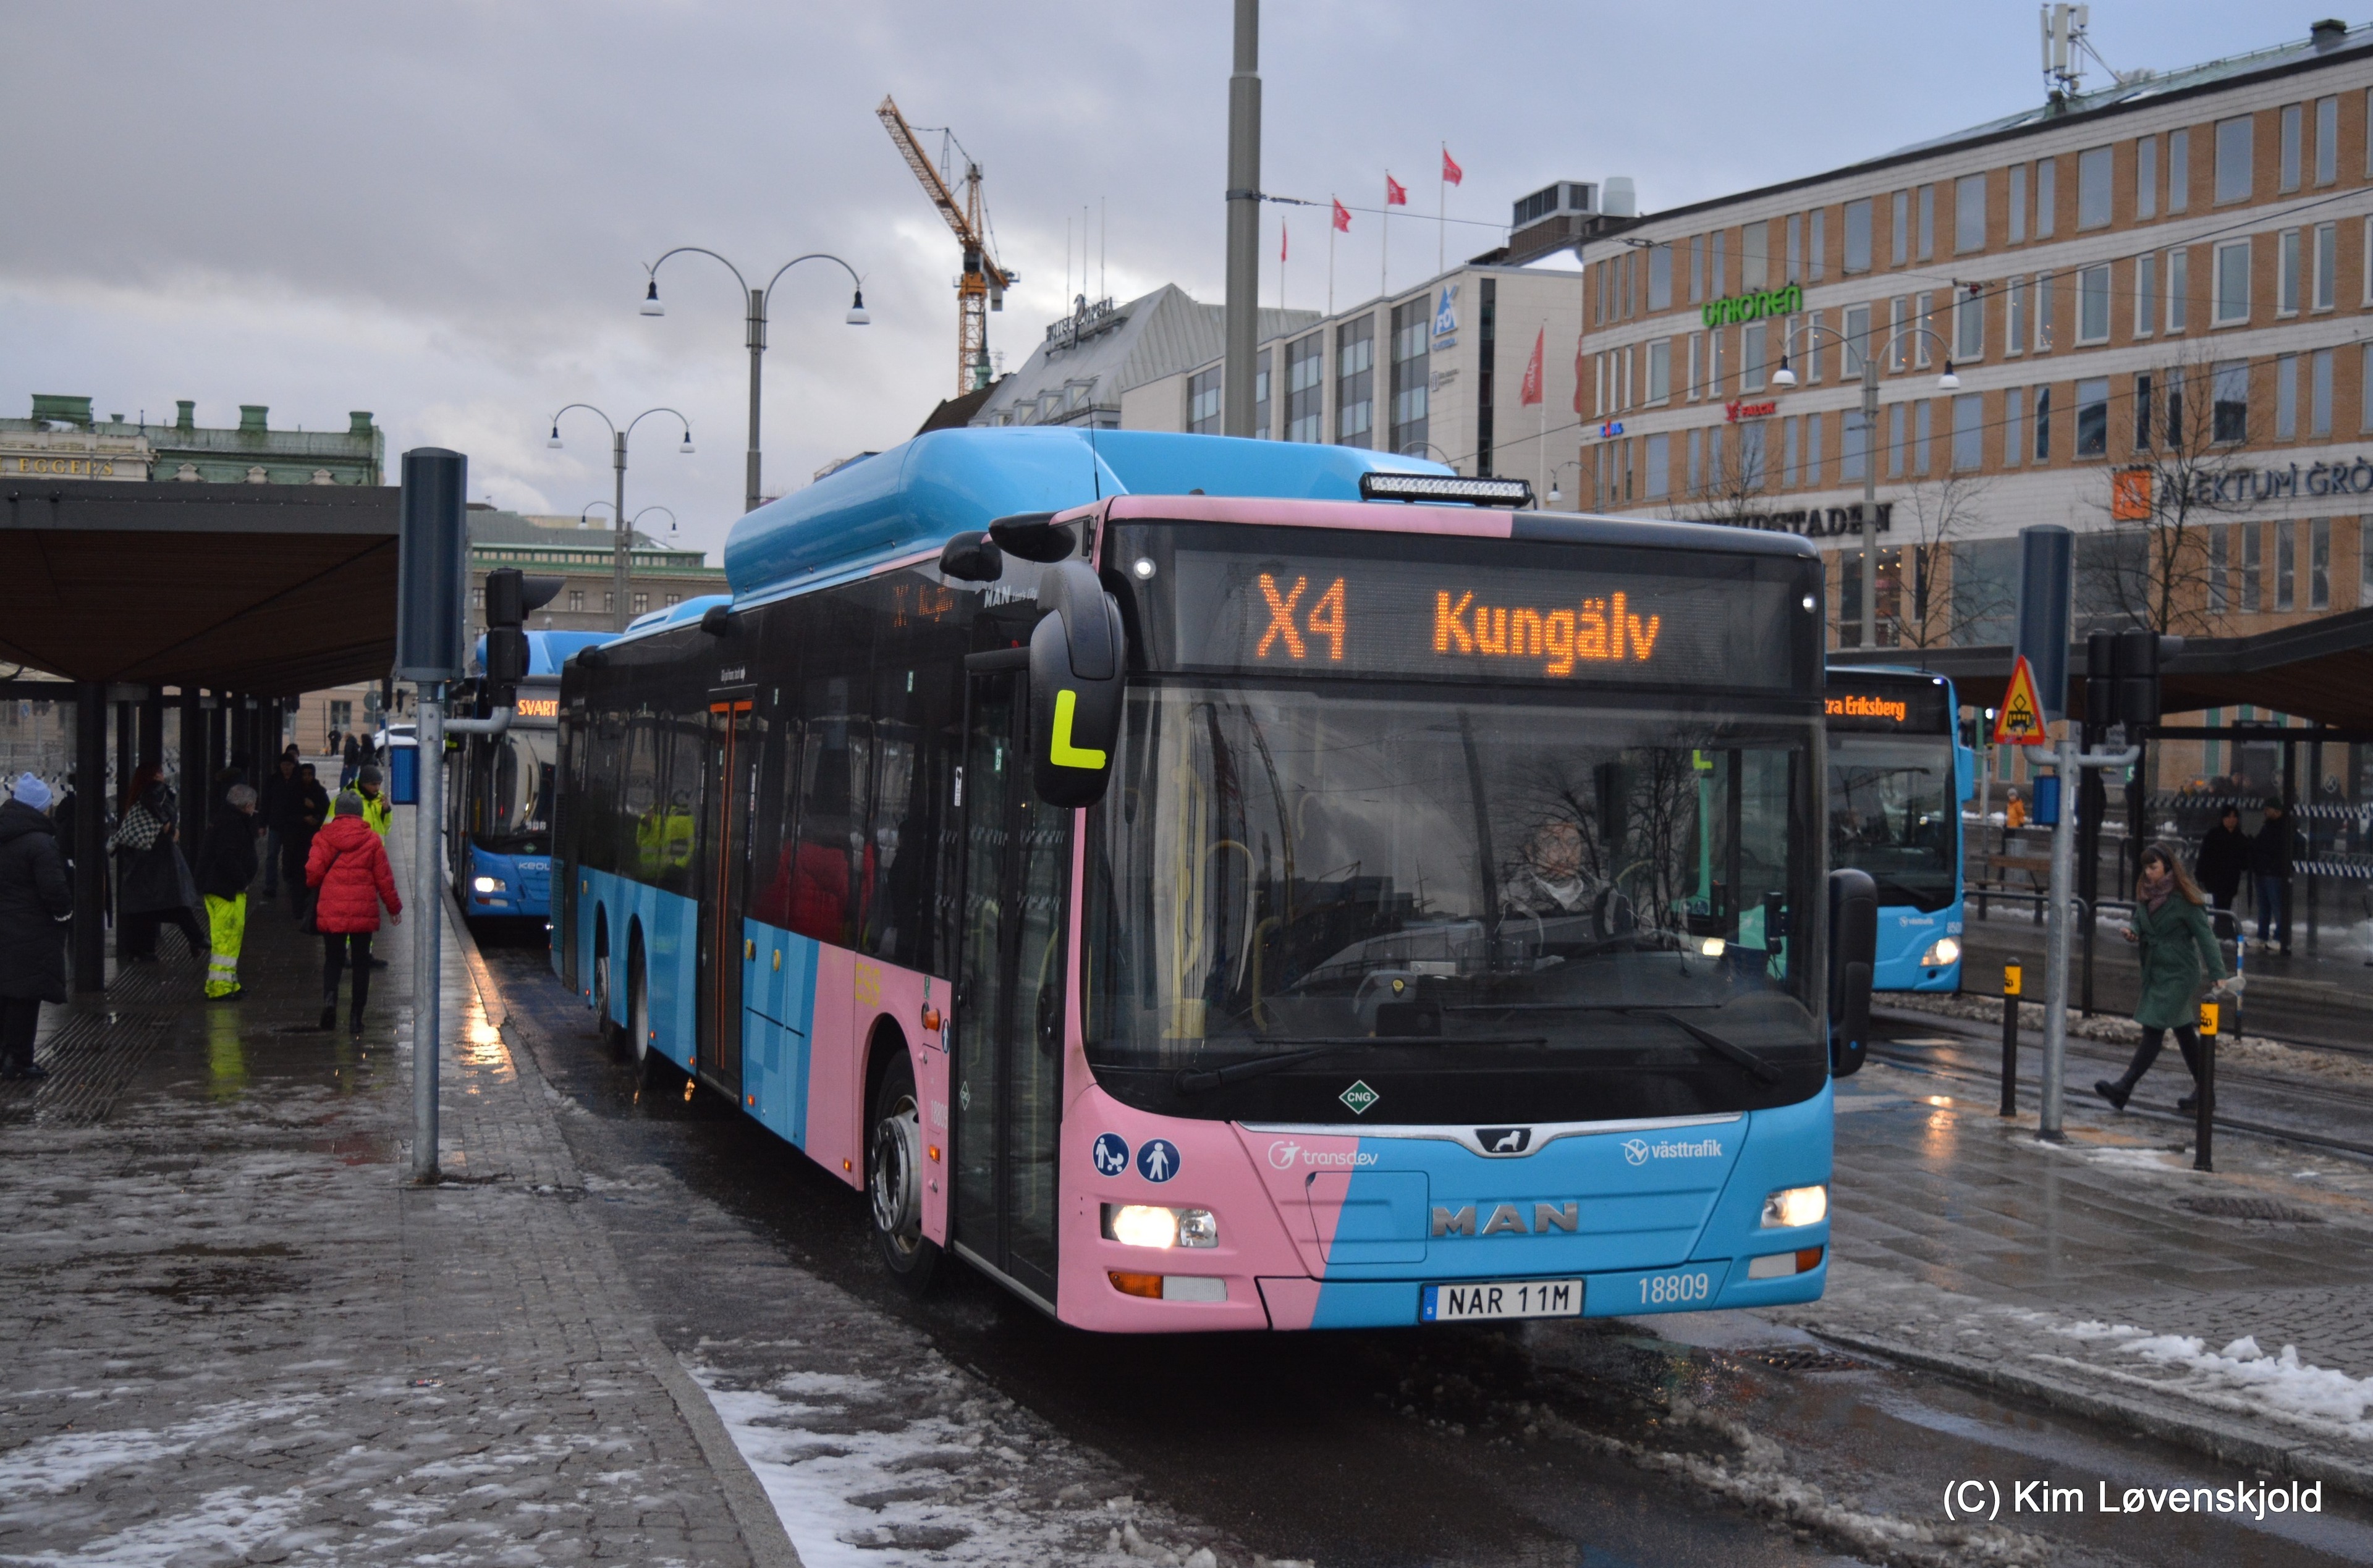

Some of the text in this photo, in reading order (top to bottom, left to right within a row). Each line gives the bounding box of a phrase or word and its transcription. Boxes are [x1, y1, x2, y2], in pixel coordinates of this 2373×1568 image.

[2159, 467, 2296, 504] AEKTUM
[1701, 503, 1893, 537] DSTADEN
[984, 586, 1011, 608] MAN
[1257, 573, 1660, 676] X4 Kungälv
[518, 699, 558, 716] SVART
[1846, 696, 1905, 721] Eriksberg
[1347, 1092, 1371, 1102] CNG
[1302, 1150, 1378, 1165] transdev
[1651, 1139, 1722, 1159] västtrafik
[1432, 1202, 1578, 1236] MAN
[1449, 1288, 1502, 1315] NAR
[1518, 1285, 1569, 1312] 11M
[1639, 1273, 1709, 1304] 18809
